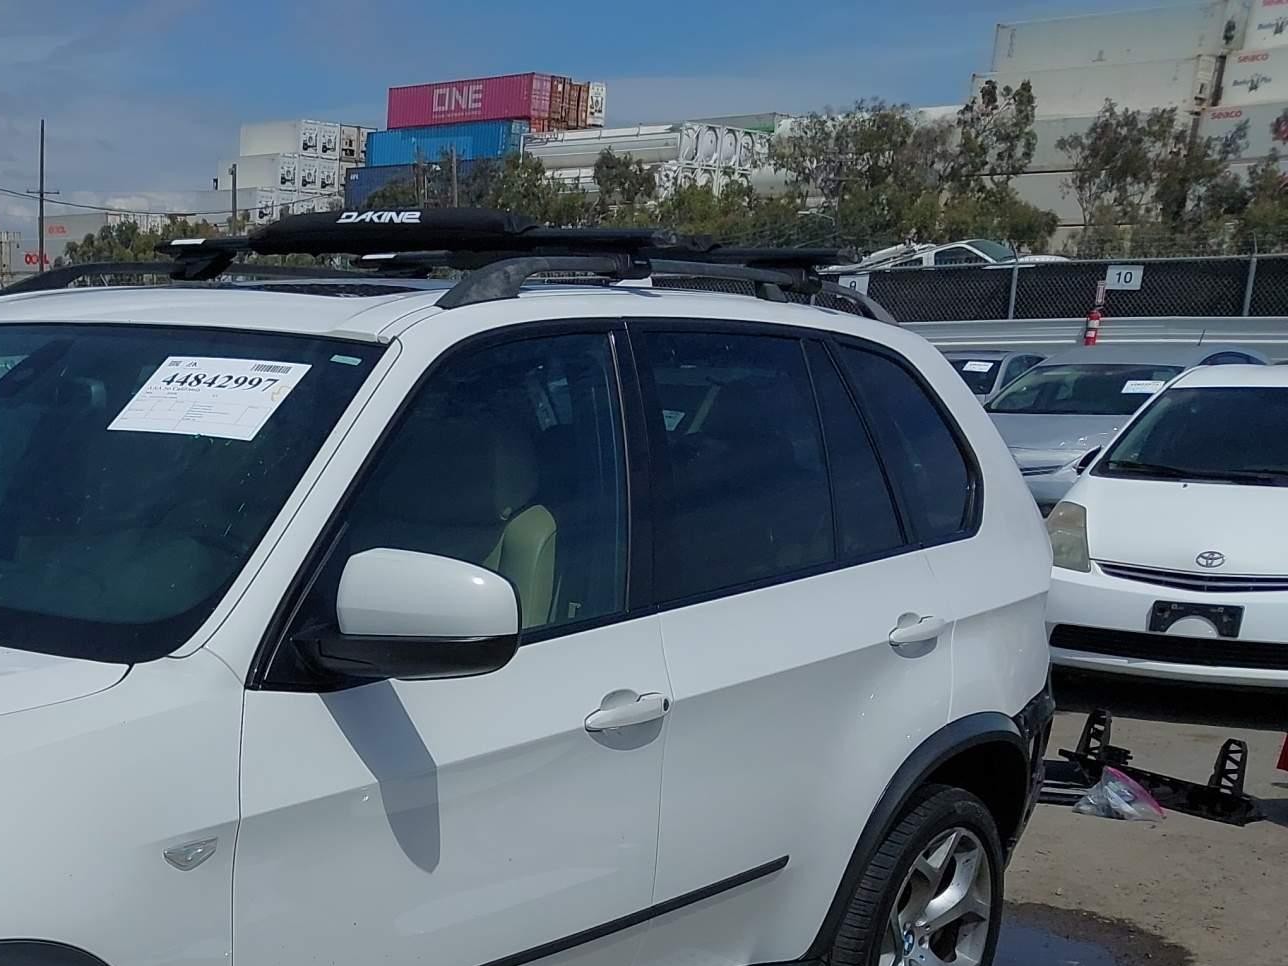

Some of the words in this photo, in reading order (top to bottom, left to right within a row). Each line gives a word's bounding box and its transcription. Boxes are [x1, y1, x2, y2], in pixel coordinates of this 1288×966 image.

[433, 85, 482, 112] ONE
[1211, 110, 1242, 119] seaco
[336, 211, 421, 223] DAKINE
[1116, 271, 1133, 284] 10
[162, 373, 280, 392] 44842997
